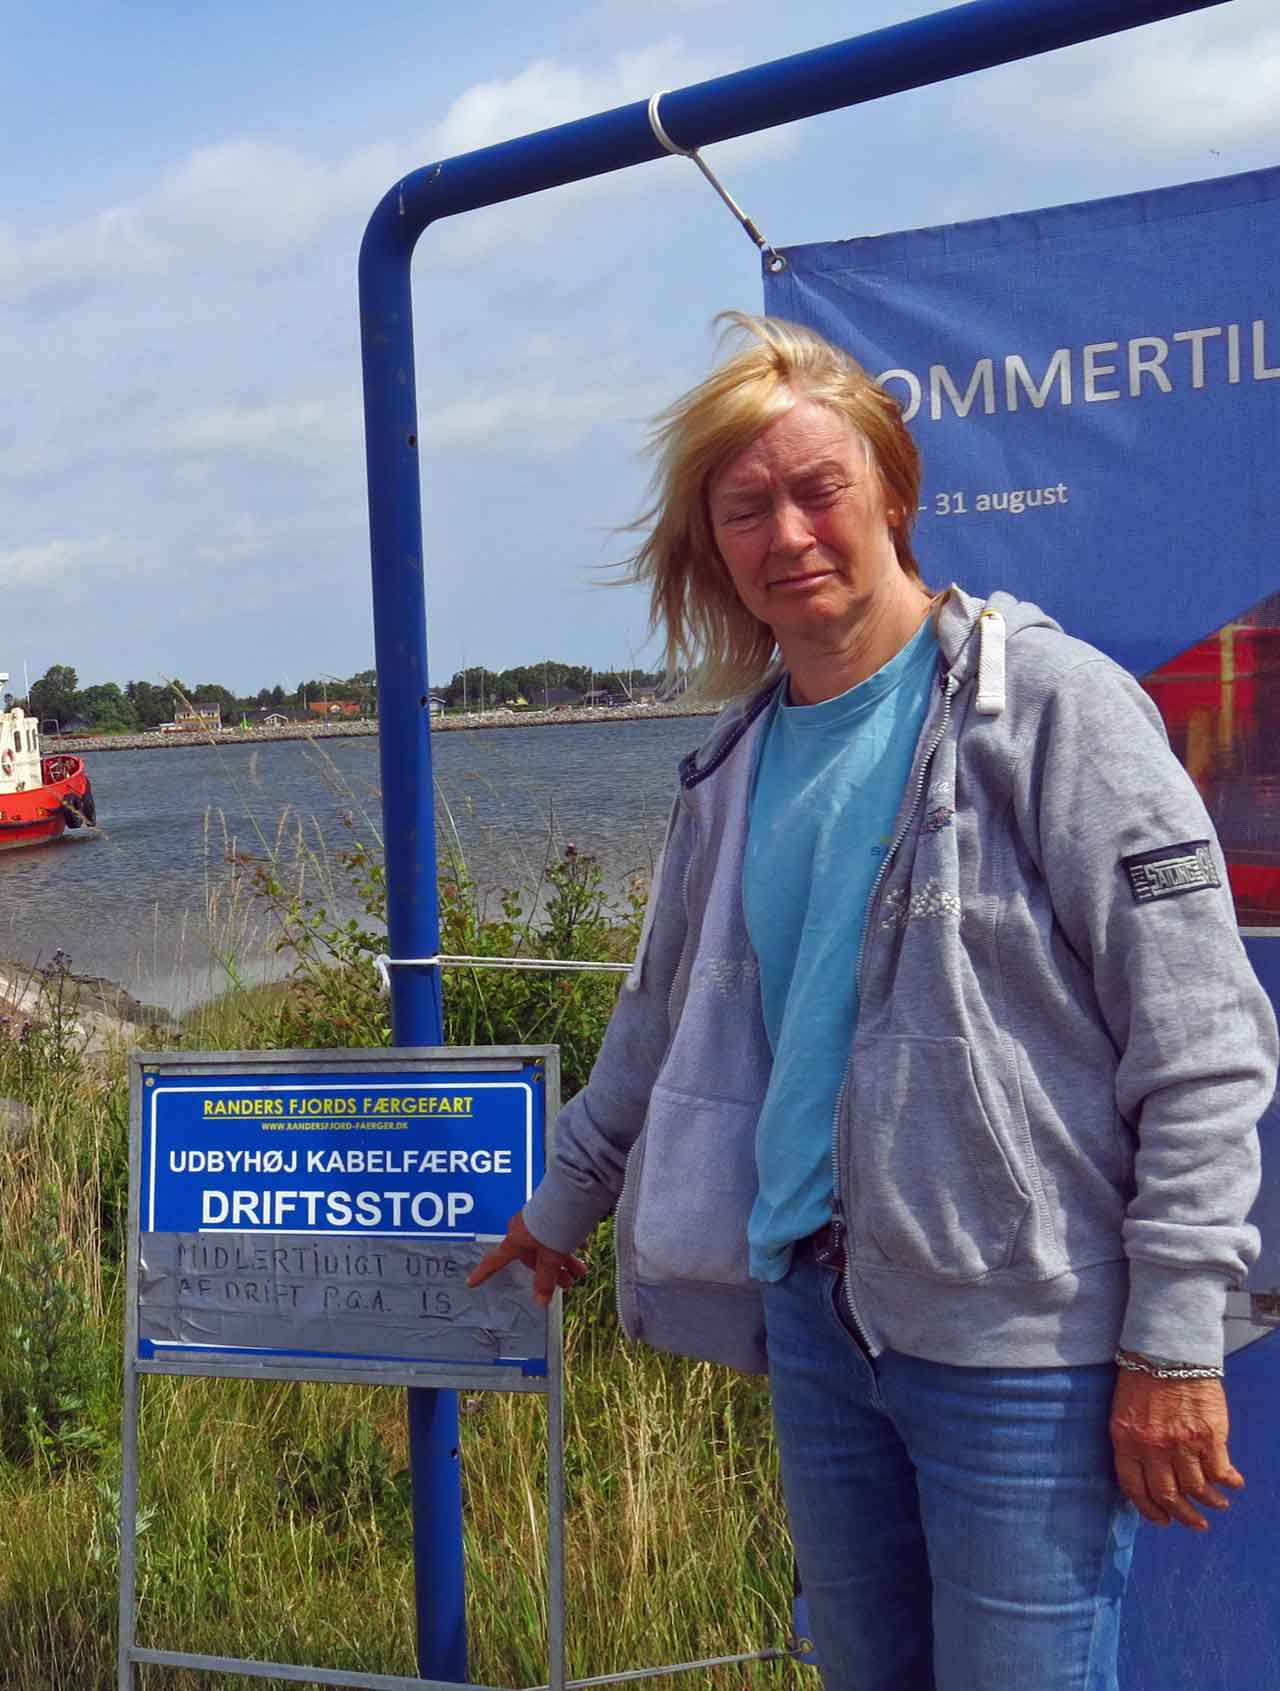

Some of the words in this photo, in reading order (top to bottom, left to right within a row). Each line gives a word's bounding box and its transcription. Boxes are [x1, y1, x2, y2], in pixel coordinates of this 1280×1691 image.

[935, 491, 968, 515] 31
[975, 483, 1068, 514] august
[204, 1099, 283, 1115] RANDERS
[289, 1098, 357, 1114] FJORDS
[363, 1097, 472, 1113] FÆRGEFART
[169, 1150, 298, 1172] UDBYHØJ
[307, 1150, 512, 1173] KABELFÆRGE
[202, 1190, 474, 1227] DRIFTSSTOP
[406, 1256, 458, 1278] UDE
[178, 1278, 211, 1296] AF
